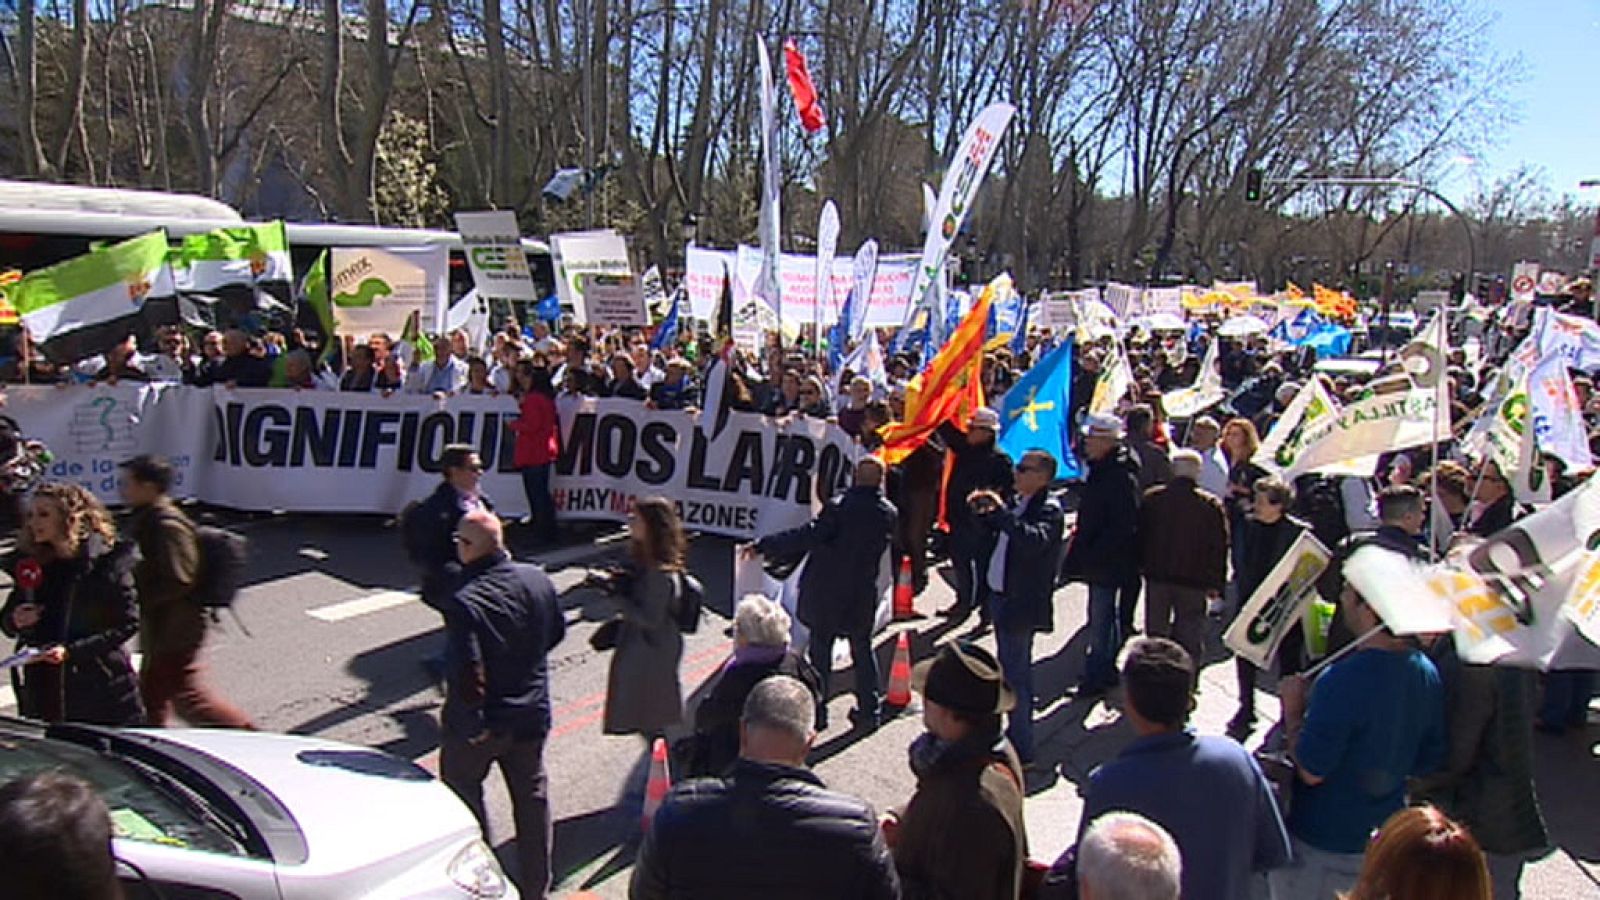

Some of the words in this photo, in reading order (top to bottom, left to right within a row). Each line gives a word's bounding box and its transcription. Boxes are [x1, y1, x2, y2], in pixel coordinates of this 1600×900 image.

[52, 460, 84, 476] de
[92, 458, 113, 475] la
[687, 426, 765, 495] LA
[553, 487, 759, 530] #HAYMAAZONES
